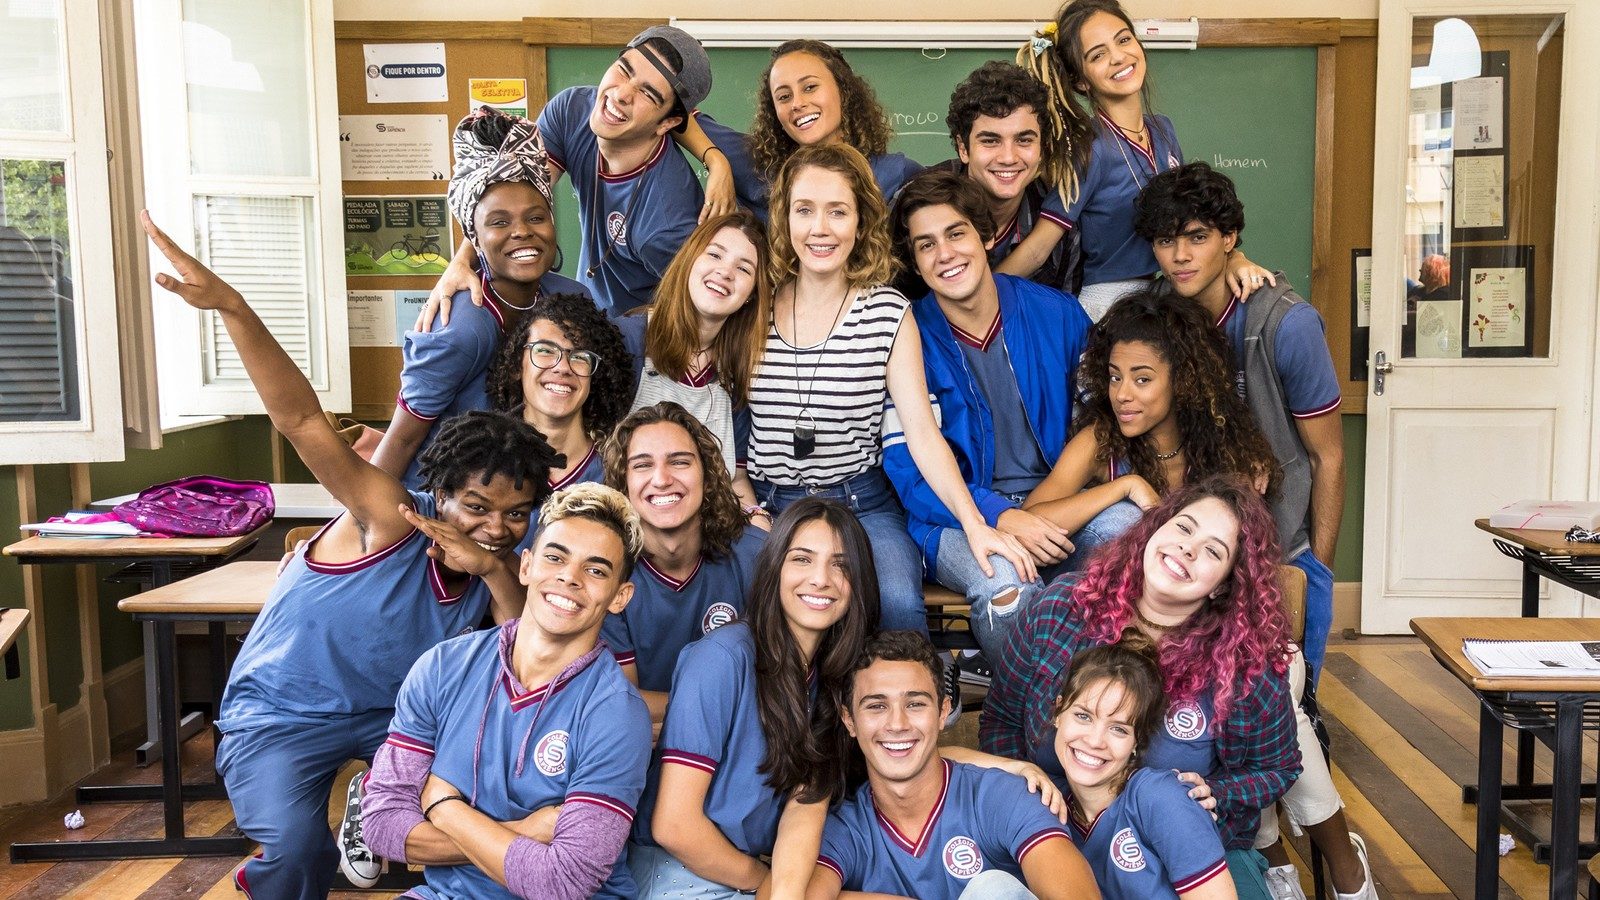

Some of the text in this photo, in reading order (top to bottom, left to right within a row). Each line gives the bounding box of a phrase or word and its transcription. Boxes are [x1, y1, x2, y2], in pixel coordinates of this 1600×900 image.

[384, 66, 442, 75] FIQUE POR DENTRO
[481, 88, 521, 97] SELETIVA
[1214, 153, 1268, 169] Homem
[347, 207, 380, 215] ECOLÓGICA
[709, 605, 734, 616] COLÉGIO
[1167, 718, 1200, 738] SAPIÊNCIA
[537, 752, 567, 773] SAPIÊNCI
[947, 839, 975, 853] COLÉGIO
[949, 857, 982, 876] SAPIÊNCIA
[1115, 855, 1145, 869] SAPIÊNC
